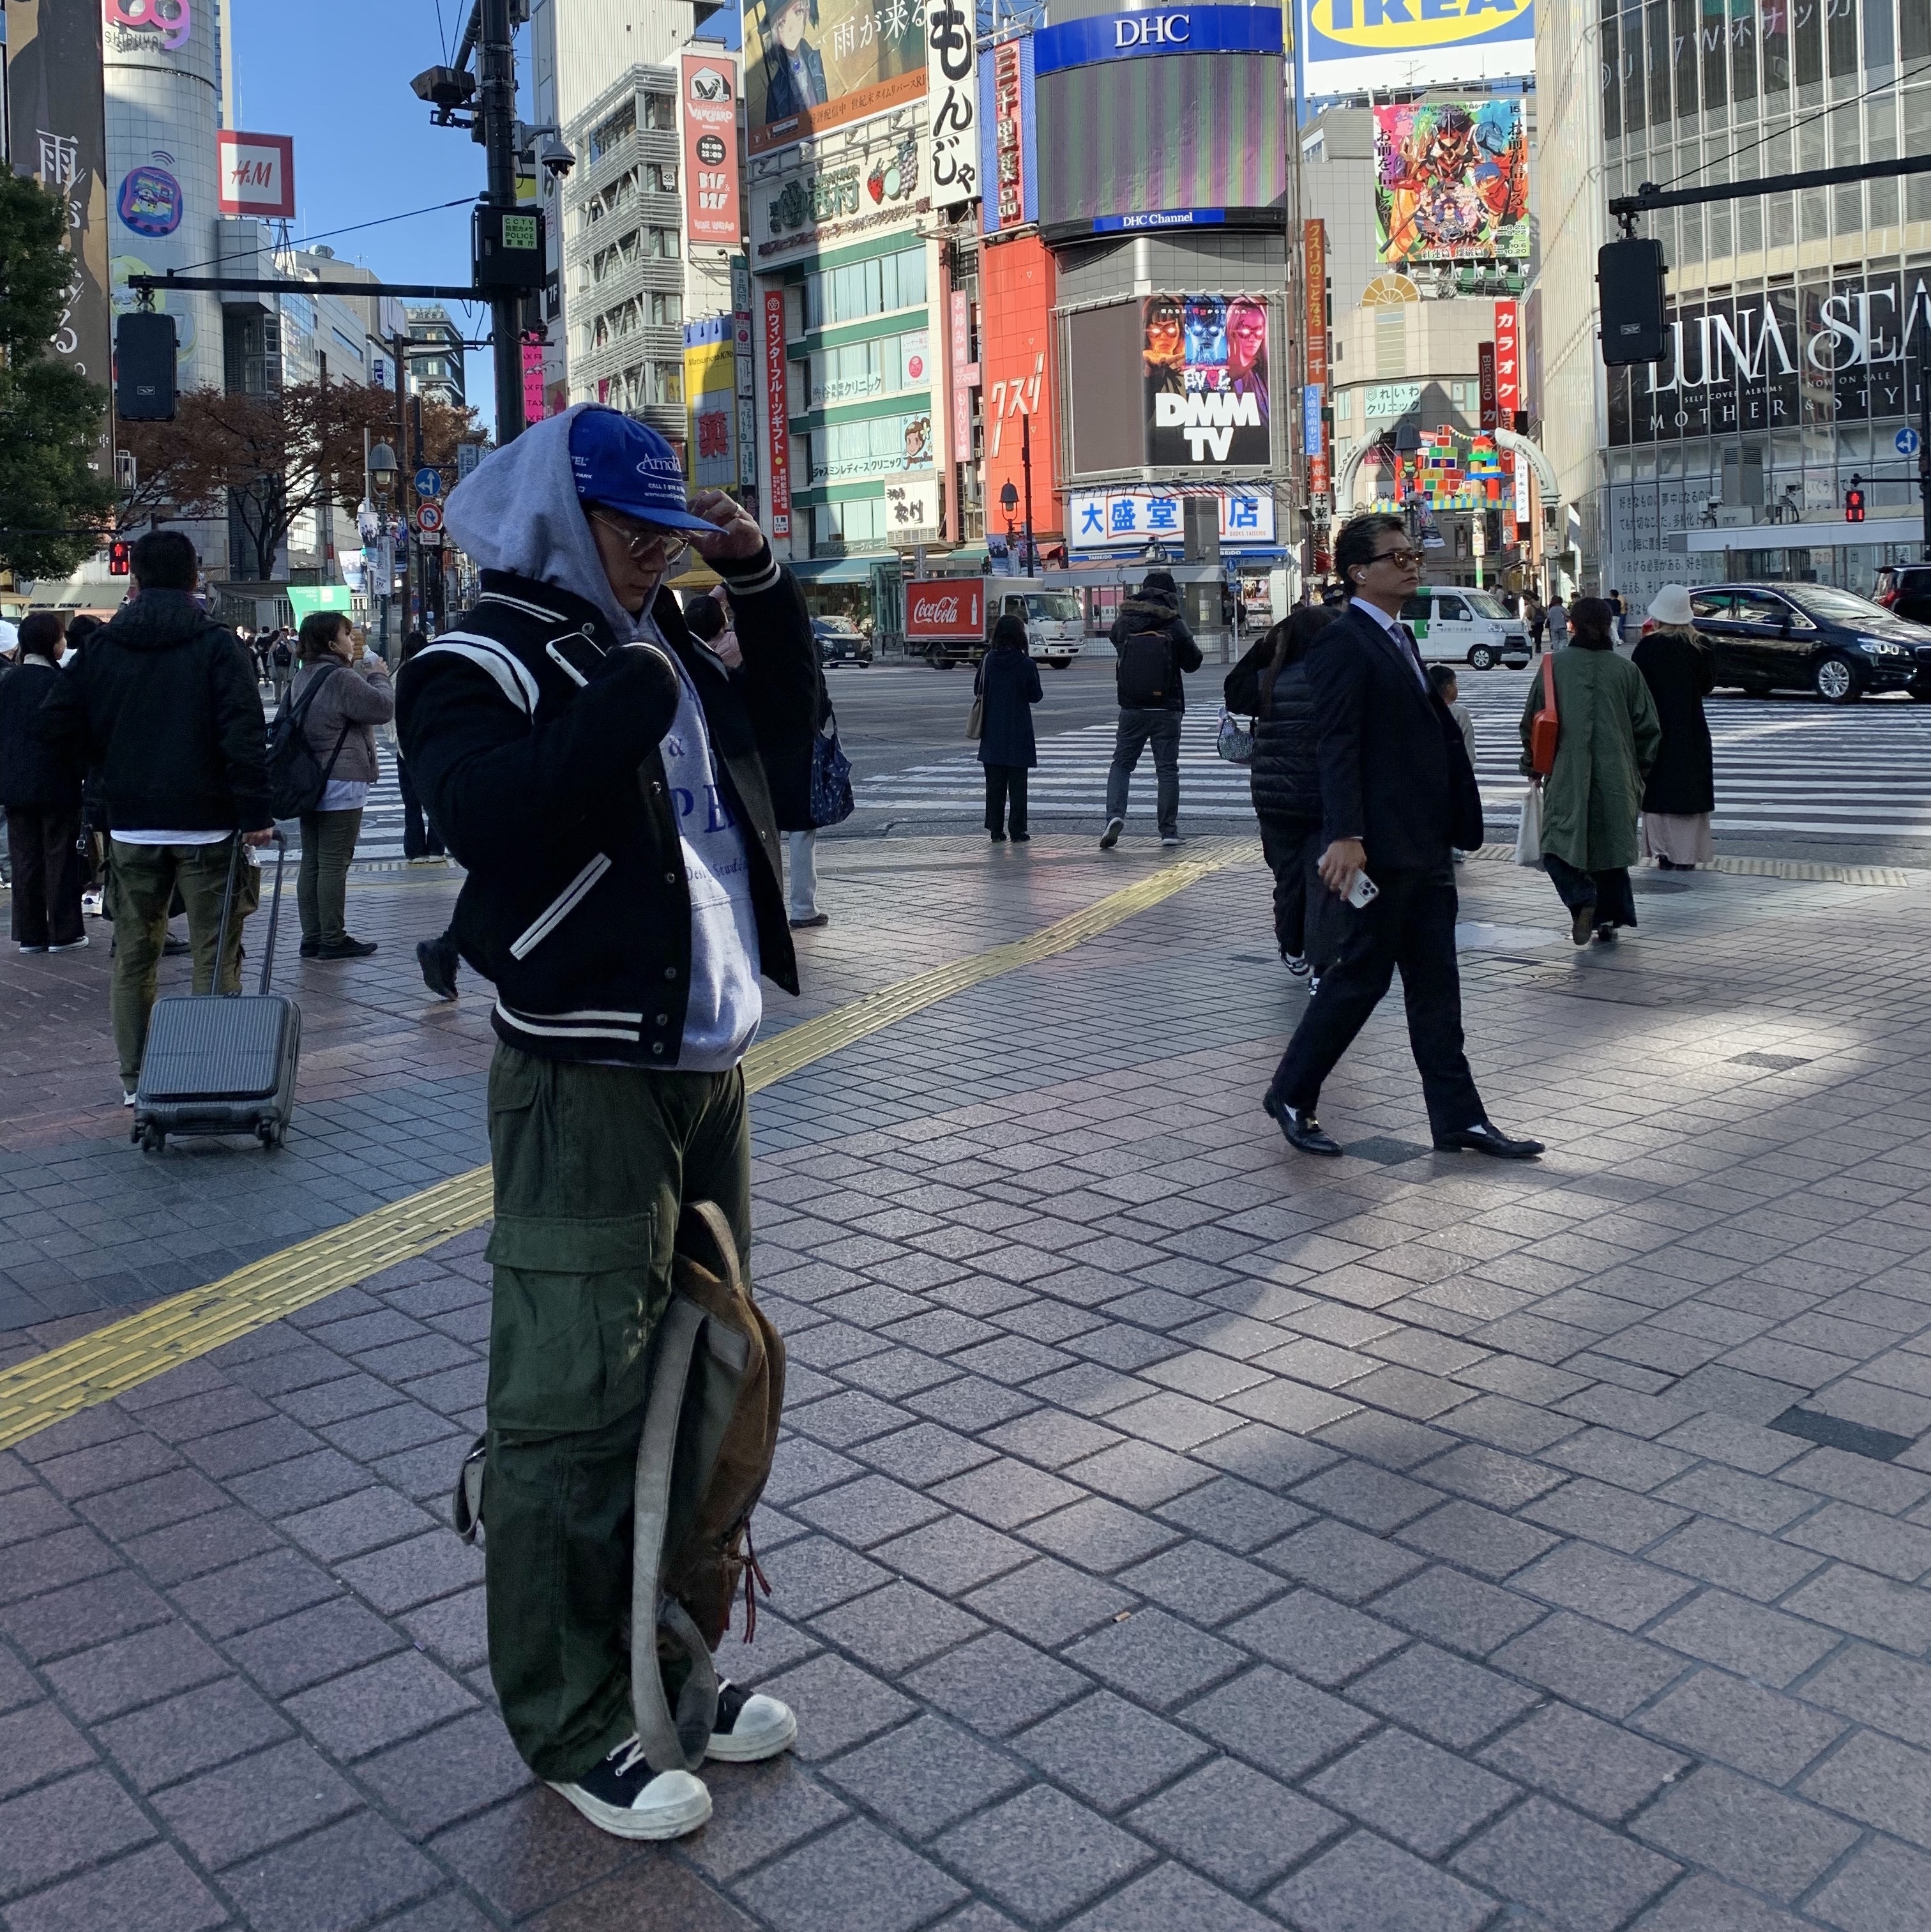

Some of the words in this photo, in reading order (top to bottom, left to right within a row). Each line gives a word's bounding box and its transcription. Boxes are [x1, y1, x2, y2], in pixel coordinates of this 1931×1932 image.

[105, 31, 159, 49] SHIBUYA
[1114, 13, 1190, 49] DHC
[686, 102, 733, 123] VANGUARD
[1510, 105, 1521, 114] 15
[994, 47, 1019, 218] 三千里薬品
[701, 142, 723, 151] 10:00
[701, 150, 722, 158] 23:00
[231, 160, 273, 188] H&M
[698, 171, 727, 190] B1F
[699, 192, 728, 209] B2F
[1123, 215, 1147, 227] DHC
[1149, 211, 1193, 224] Channel
[1307, 224, 1326, 328] クスリのことなら
[549, 284, 557, 303] 7F
[1497, 313, 1517, 398] カラオケ
[1644, 300, 1798, 394] LUNA
[1482, 354, 1492, 372] BIG
[768, 313, 784, 455] ウィンターフルーツギフト
[1484, 374, 1492, 401] ECHO
[1806, 378, 1833, 389] NOW
[1839, 376, 1856, 384] ON
[1863, 371, 1891, 382] SALE
[1379, 386, 1420, 400] れいわ
[1684, 395, 1704, 404] SELF
[1745, 384, 1783, 397] ALBUMS
[991, 351, 1046, 459] クスリ
[1155, 392, 1261, 427] DMM
[1367, 400, 1420, 416] クリニック
[1649, 399, 1788, 431] MOTHER
[1805, 399, 1815, 410] &
[698, 409, 729, 458] 薬
[1184, 427, 1234, 461] TV
[812, 457, 902, 478] ジャスミンレディースクリニック
[913, 597, 960, 624] Coca-Cola
